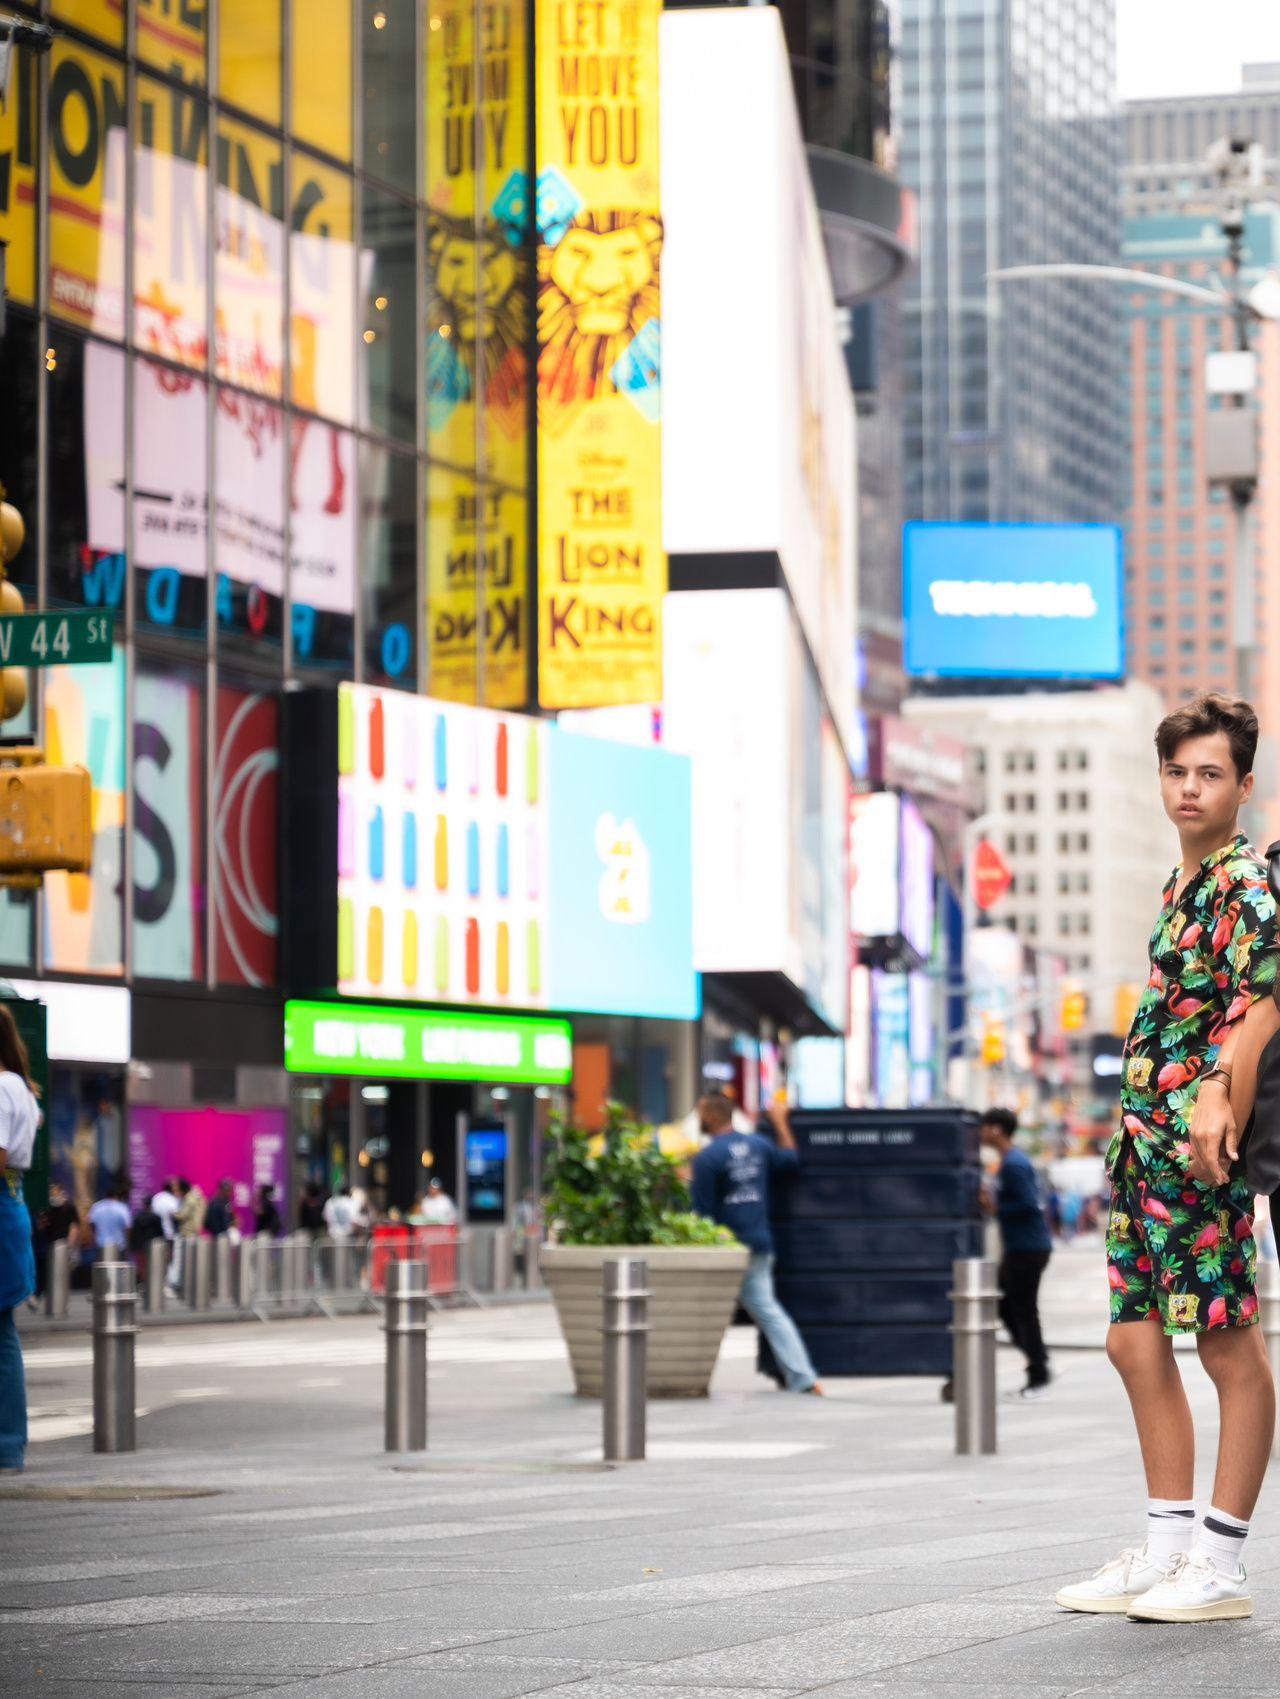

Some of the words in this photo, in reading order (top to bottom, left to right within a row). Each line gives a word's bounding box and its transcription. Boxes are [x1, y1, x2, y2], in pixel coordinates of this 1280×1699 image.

[558, 56, 637, 96] MOVE
[561, 105, 638, 165] YOU
[569, 488, 630, 515] THE
[558, 536, 642, 583] LION
[31, 618, 71, 661] 44
[87, 616, 107, 644] St
[549, 597, 654, 648] KING
